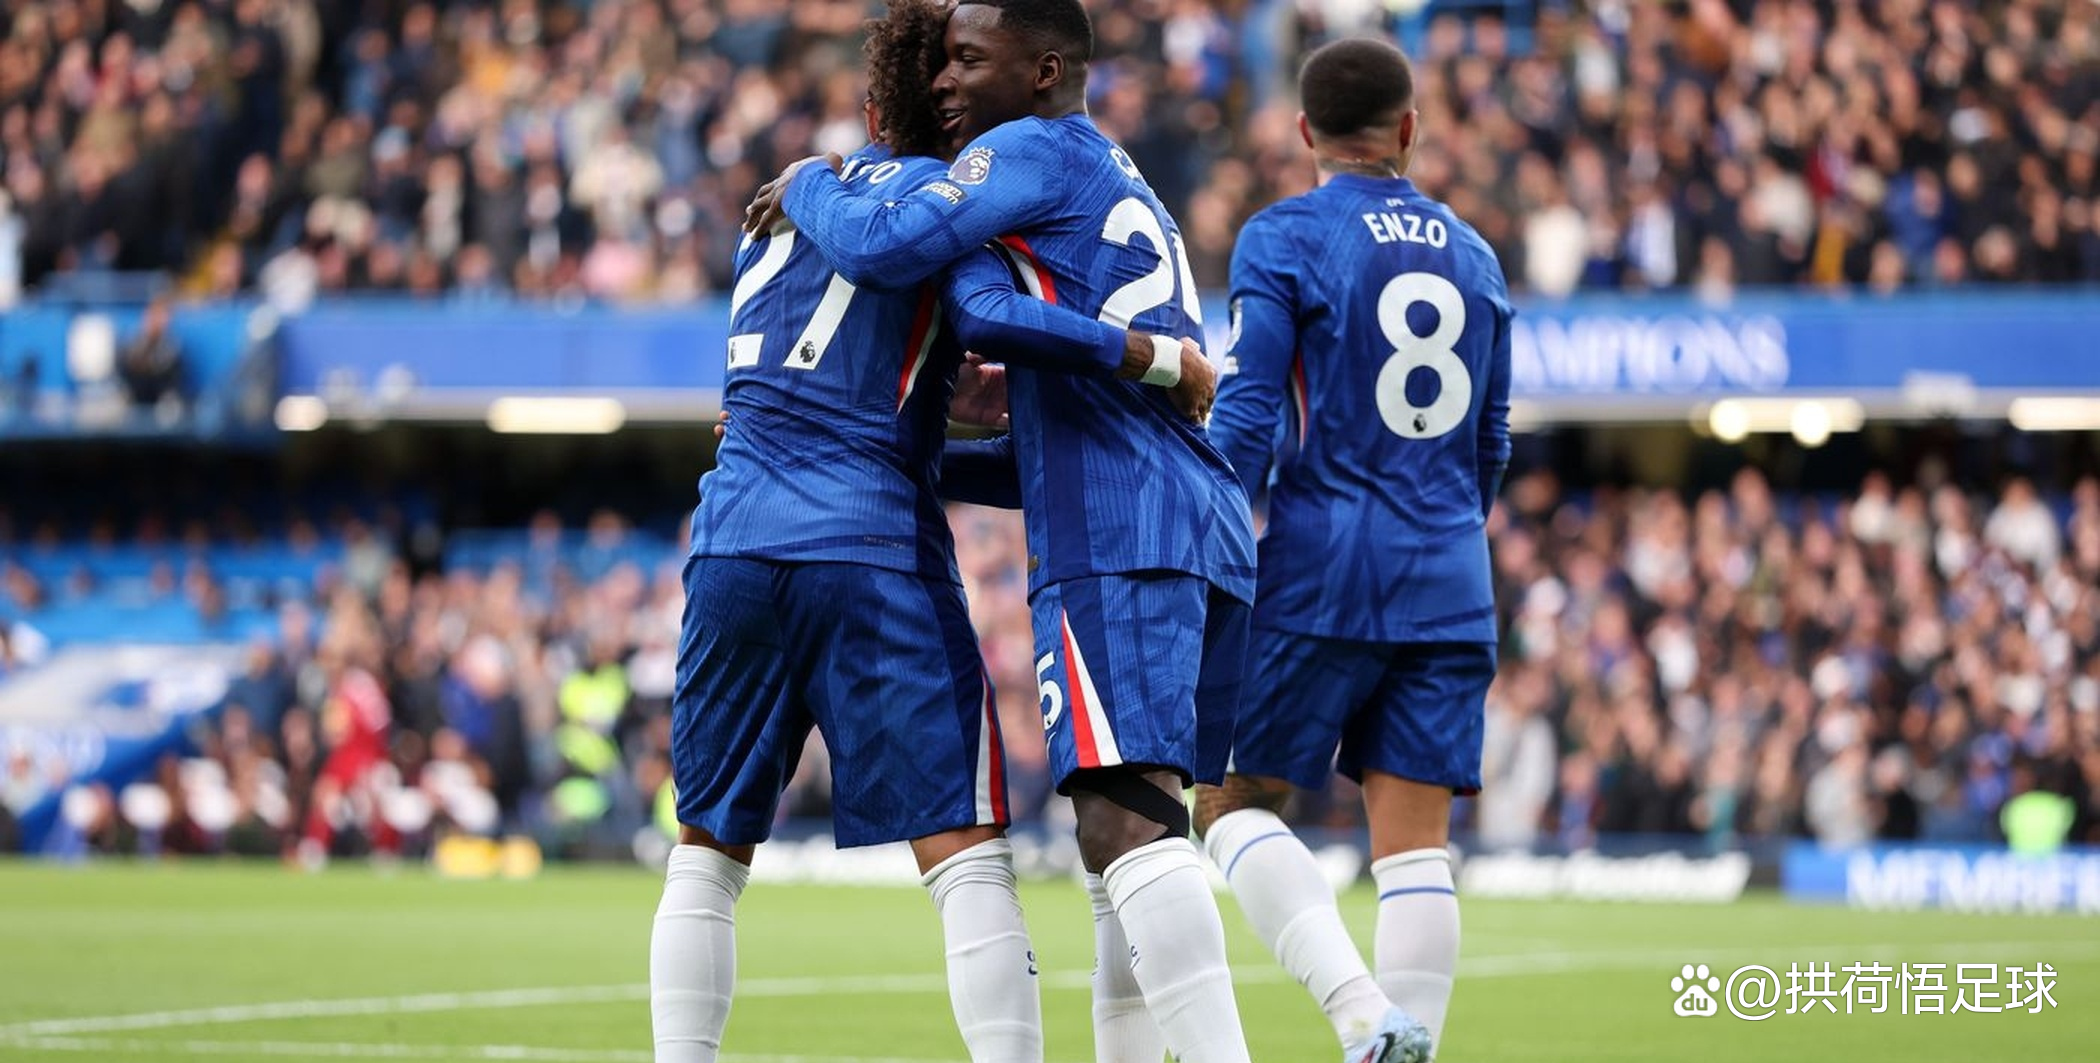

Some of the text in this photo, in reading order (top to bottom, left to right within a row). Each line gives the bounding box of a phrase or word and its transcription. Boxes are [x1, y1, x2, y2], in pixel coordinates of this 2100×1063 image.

[727, 218, 856, 370] 27
[1362, 212, 1448, 249] ENZO
[1375, 272, 1472, 439] 8
